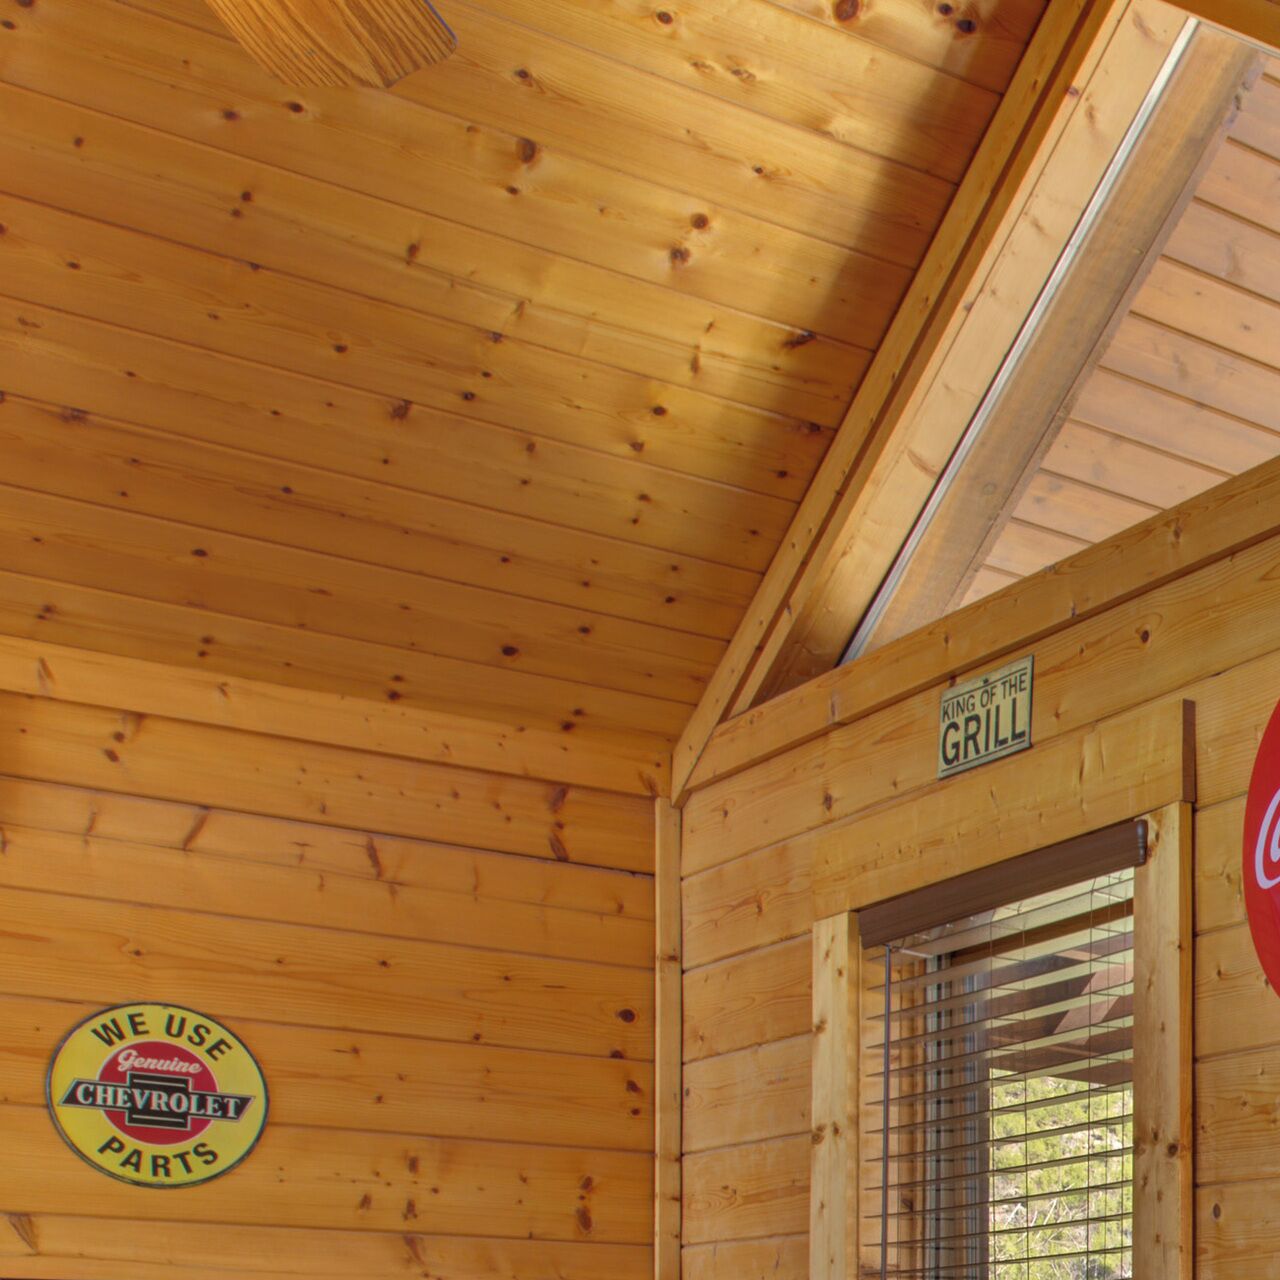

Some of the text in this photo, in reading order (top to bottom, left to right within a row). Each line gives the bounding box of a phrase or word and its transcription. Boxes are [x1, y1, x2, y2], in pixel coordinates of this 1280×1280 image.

[942, 671, 1027, 723] KING OF THE
[941, 697, 1026, 766] GRILL
[91, 1012, 233, 1061] WE USE
[117, 1049, 203, 1074] Genuine
[76, 1083, 241, 1118] CHEVROLET
[97, 1135, 219, 1177] PARTS
